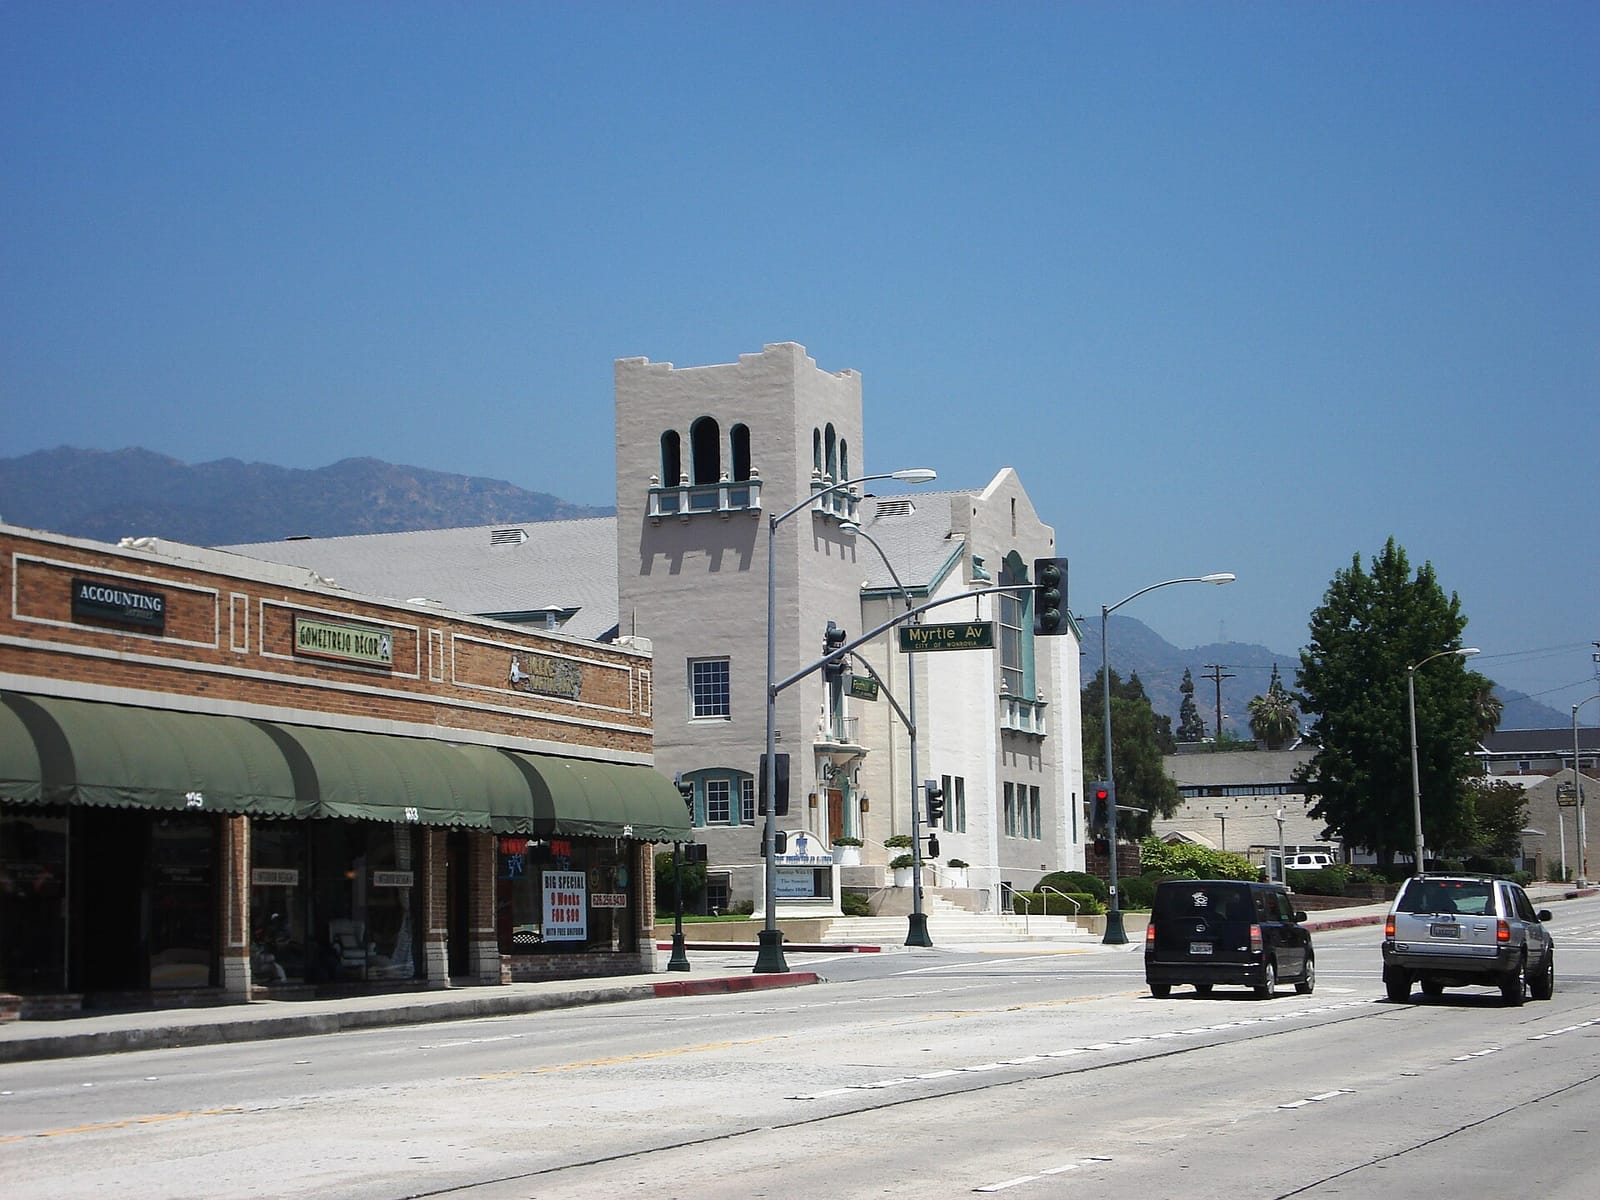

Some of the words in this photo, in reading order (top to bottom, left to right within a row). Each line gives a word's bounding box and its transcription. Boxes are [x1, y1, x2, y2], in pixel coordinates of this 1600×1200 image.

[80, 585, 162, 611] ACCOUNTING
[300, 626, 351, 652] GOMEZTREJO
[909, 627, 956, 643] Myrtle
[965, 626, 983, 638] Av
[185, 792, 204, 807] 105
[545, 876, 556, 889] BIG
[559, 876, 584, 889] SPECIAL
[557, 892, 580, 906] Weeks
[552, 909, 564, 922] FOR
